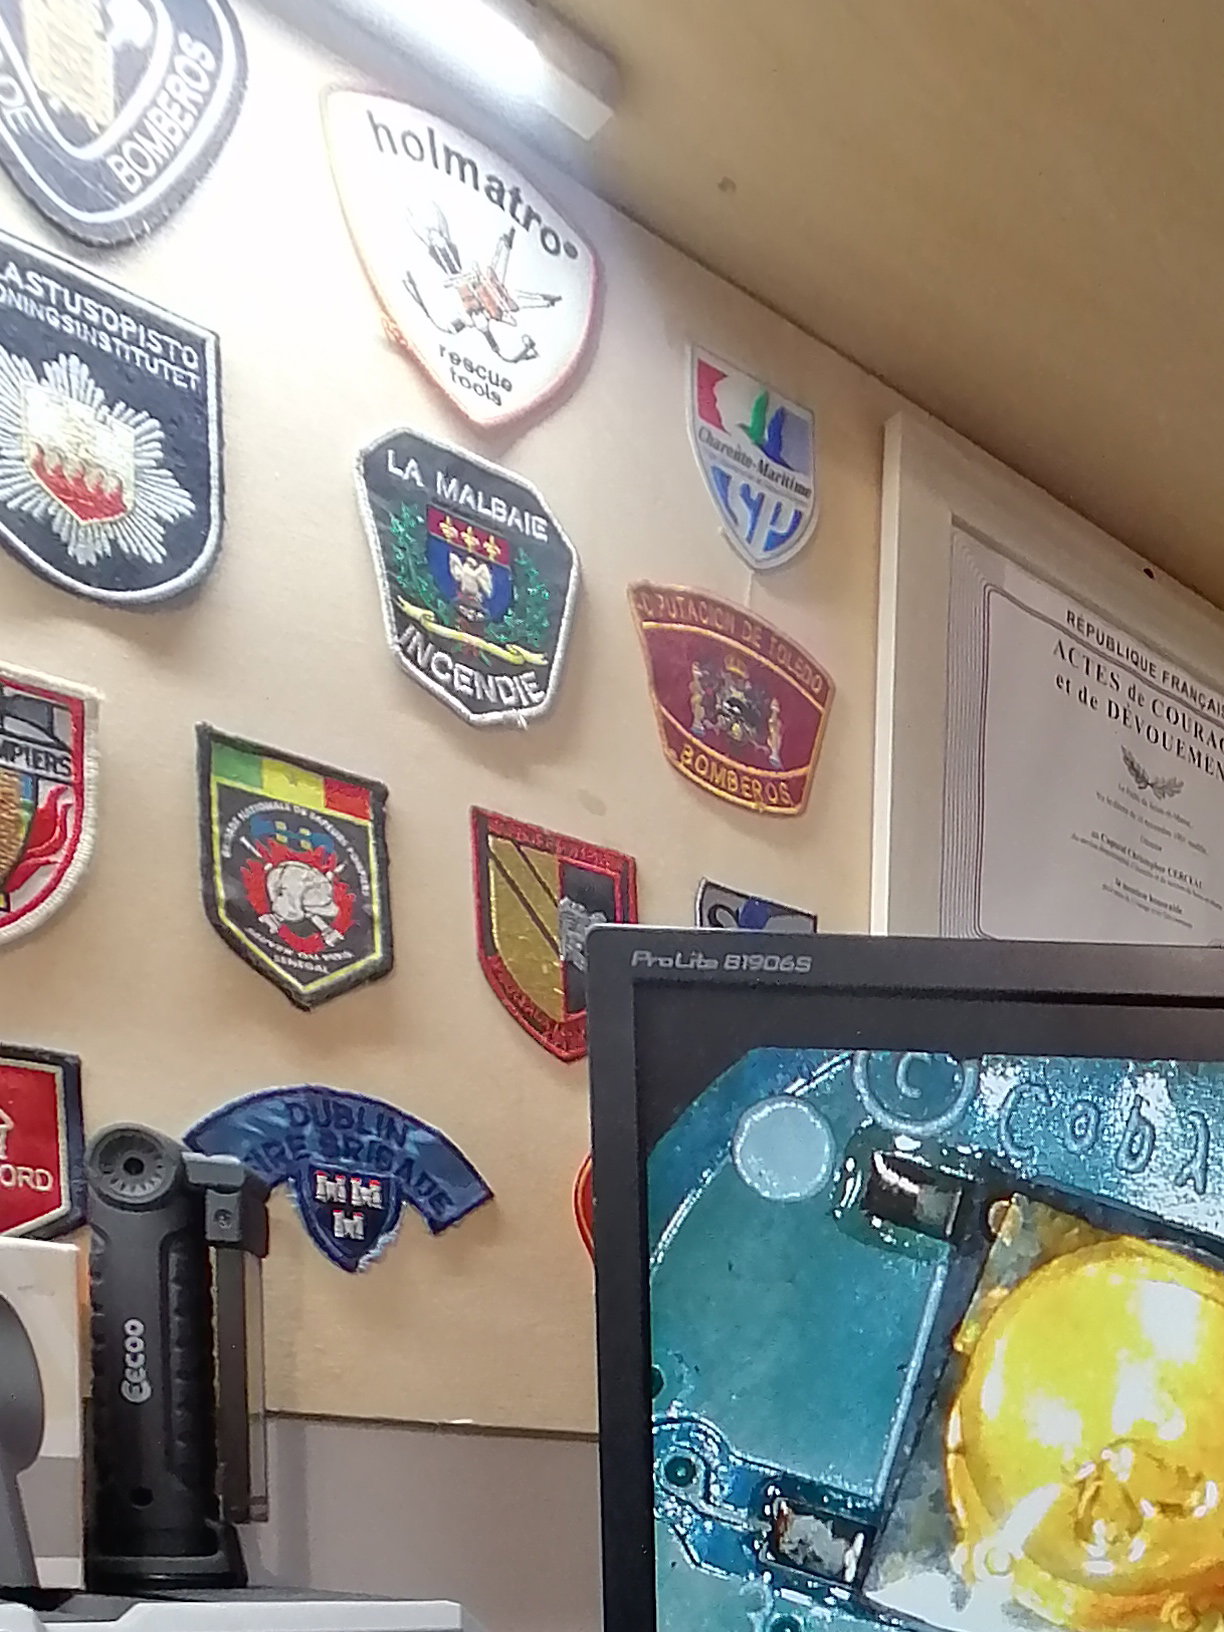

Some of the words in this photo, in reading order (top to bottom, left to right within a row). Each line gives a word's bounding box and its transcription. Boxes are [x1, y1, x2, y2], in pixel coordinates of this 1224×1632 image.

[105, 32, 217, 194] BOMBEROS
[367, 109, 563, 256] holmatro
[0, 261, 199, 370] ASTUSOPISTO
[439, 344, 514, 393] rescue
[450, 367, 502, 407] tools
[387, 449, 425, 488] LA
[435, 471, 549, 542] MALBAIE
[399, 623, 547, 706] INCENDIE
[1052, 638, 1121, 693] ACTES
[1127, 678, 1146, 707] de
[1065, 608, 1158, 679] RÉPUBLIQUE
[1055, 672, 1071, 692] et
[1078, 688, 1099, 711] de
[679, 745, 794, 806] BOMBEROS
[630, 950, 719, 970] ProLite
[288, 1100, 408, 1147] DUBLIN
[318, 1129, 454, 1214] BRIGADE
